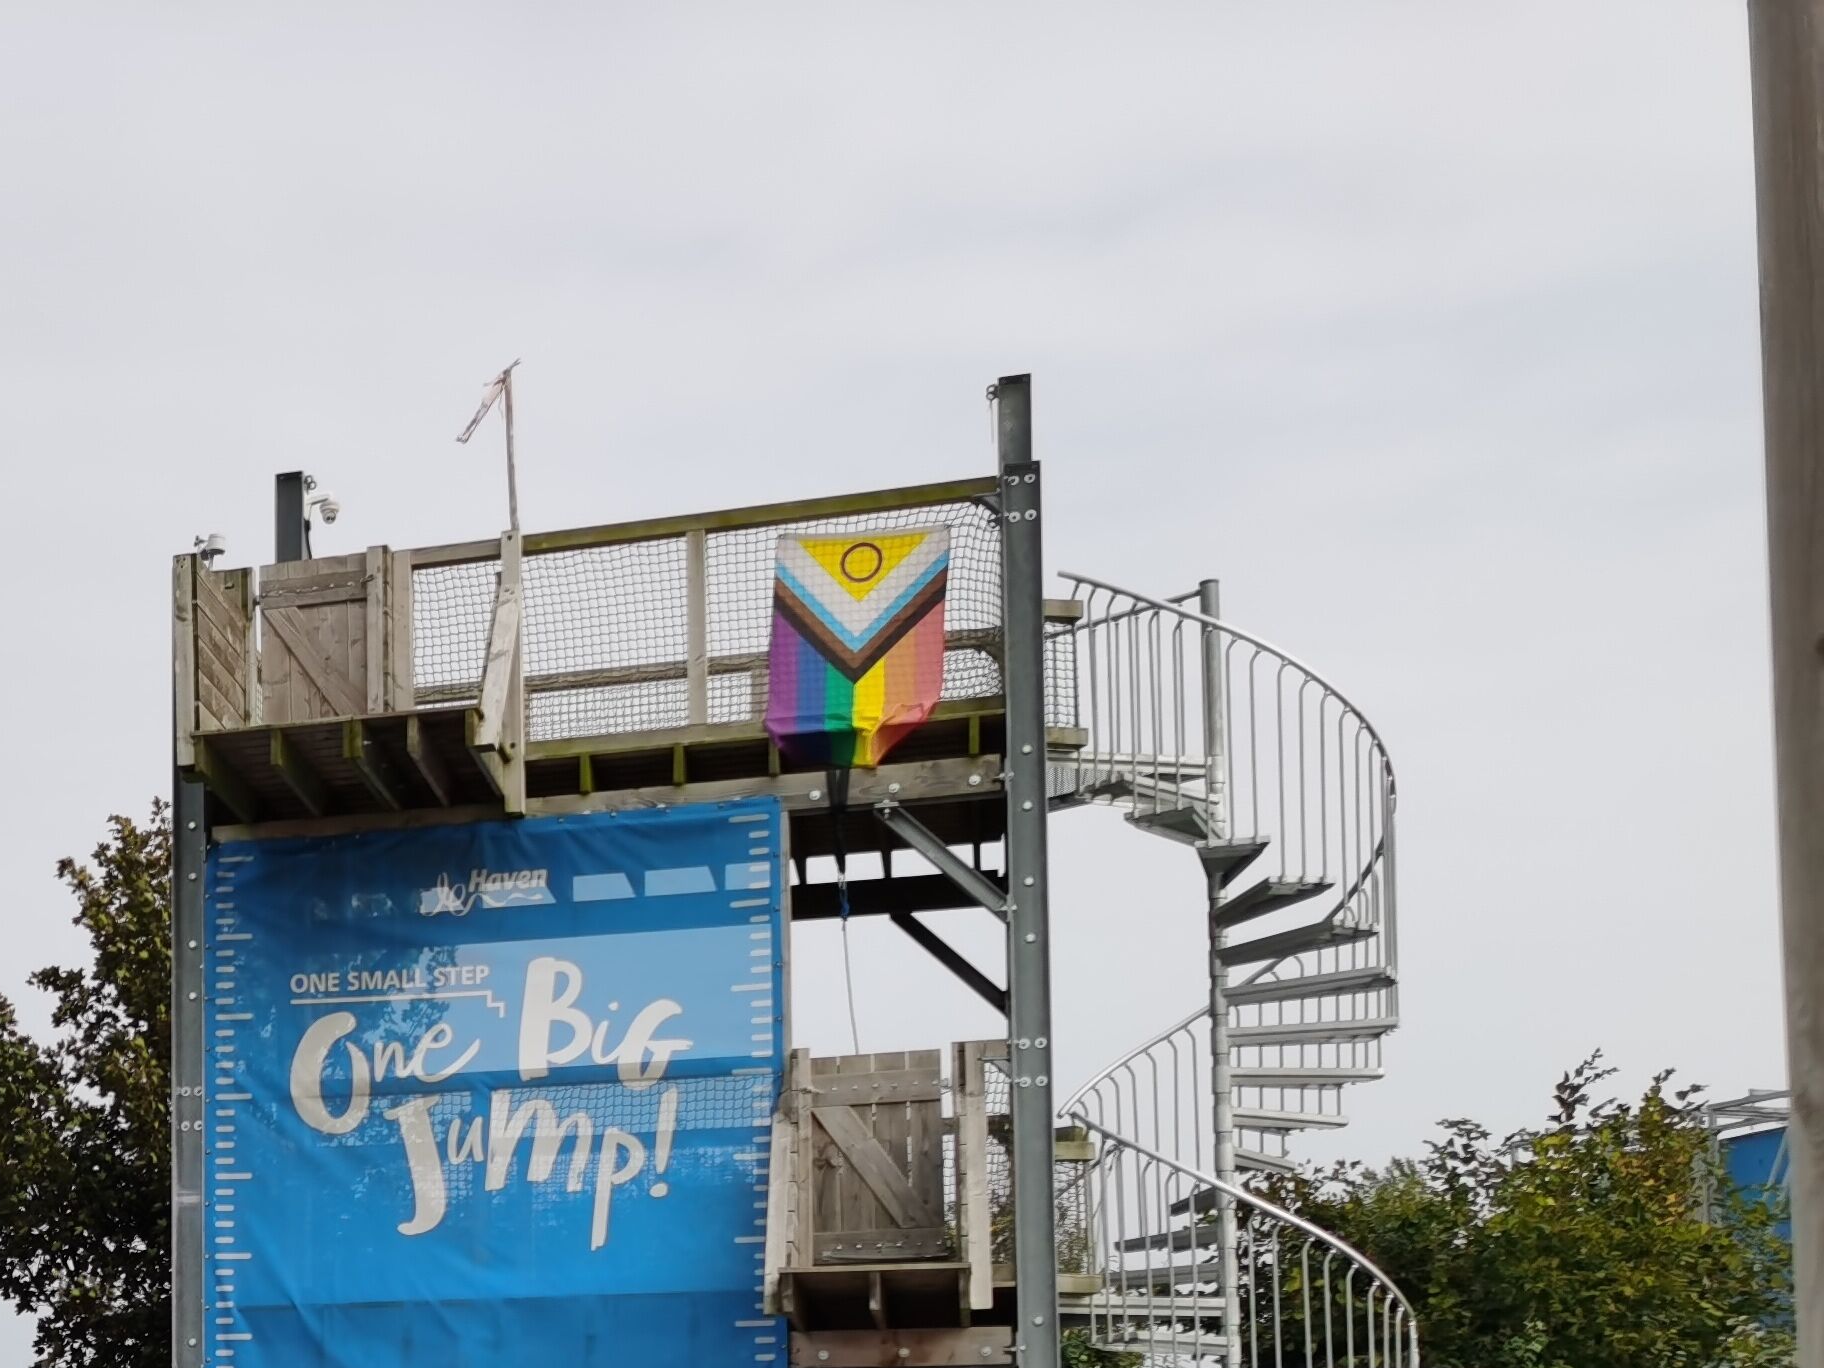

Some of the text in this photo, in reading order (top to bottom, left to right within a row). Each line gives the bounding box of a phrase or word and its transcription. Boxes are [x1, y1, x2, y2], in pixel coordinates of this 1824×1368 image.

[468, 868, 548, 893] Haven
[290, 965, 490, 994] ONE SMALL STEP
[290, 1011, 481, 1135] One
